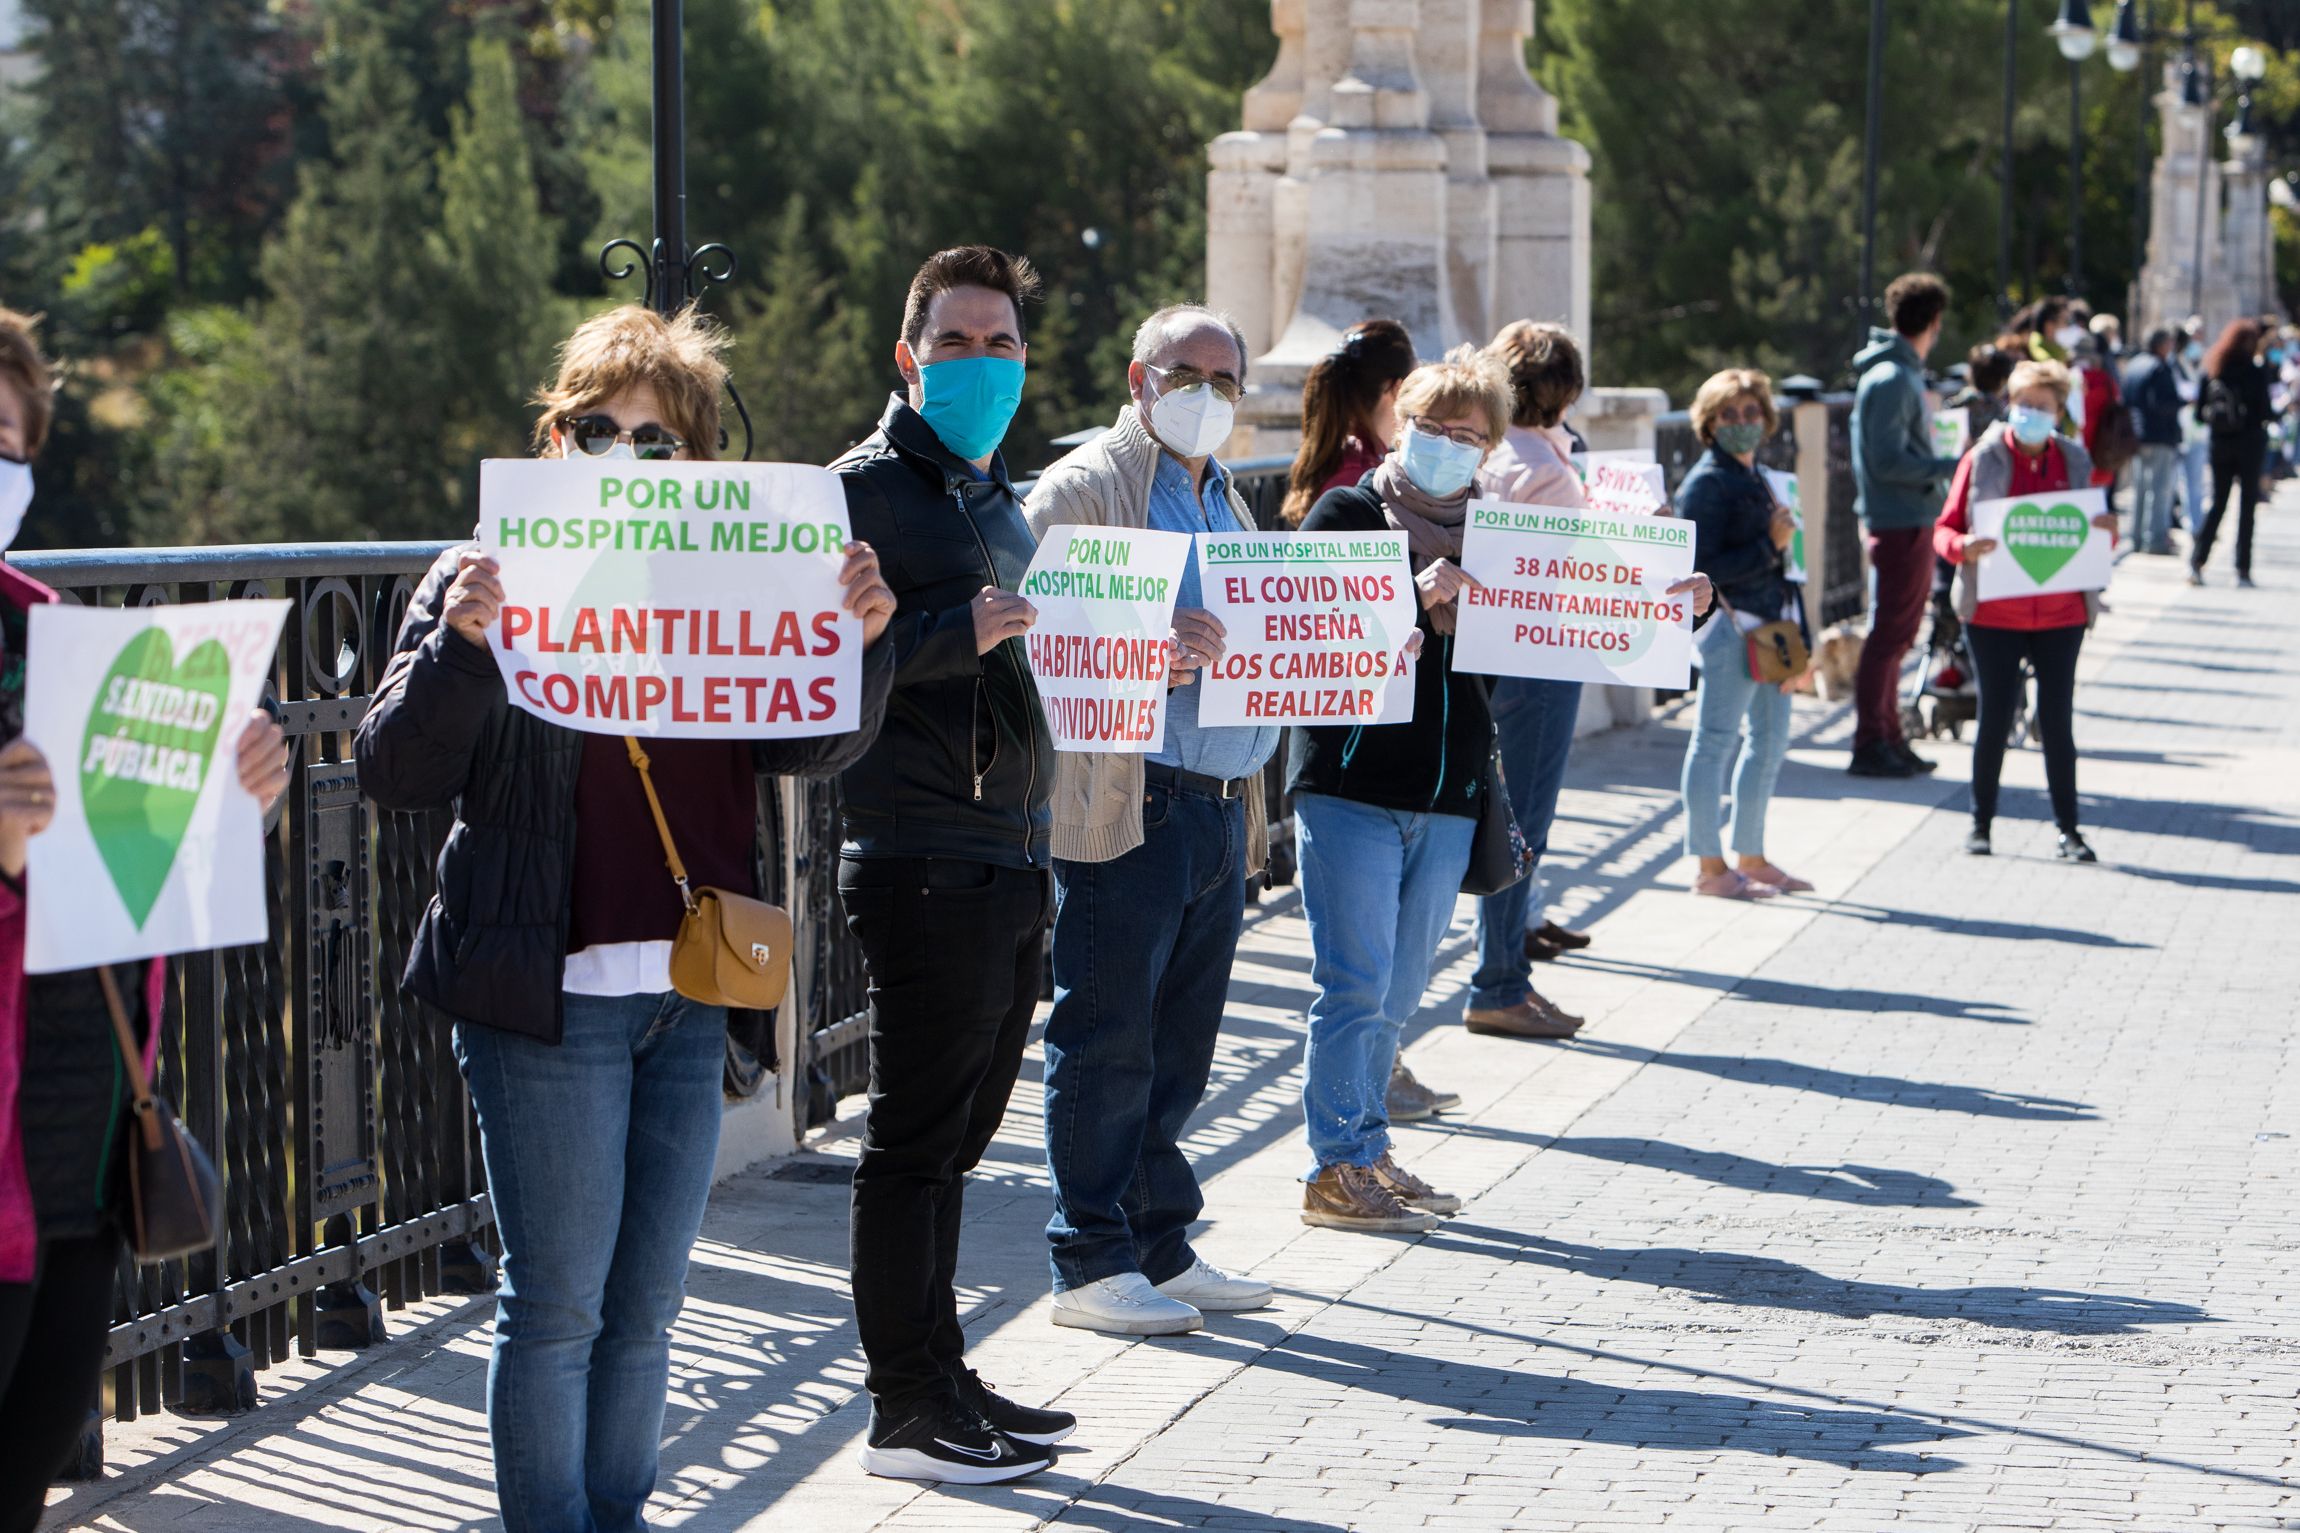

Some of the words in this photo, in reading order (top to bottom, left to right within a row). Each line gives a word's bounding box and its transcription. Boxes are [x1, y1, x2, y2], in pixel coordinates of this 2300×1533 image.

[600, 477, 682, 510] POR
[694, 480, 750, 511] UN
[500, 517, 699, 552] HOSPITAL
[710, 522, 844, 554] MEJOR
[1474, 509, 1509, 527] POR
[1514, 513, 1539, 529] UN
[1543, 516, 1629, 538] HOSPITAL
[1632, 521, 1688, 544] MEJOR
[1066, 538, 1102, 565] POR
[1104, 540, 1131, 567] UN
[1206, 543, 1242, 559] POR
[1246, 543, 1269, 558] UN
[1272, 542, 1346, 558] HOSPITAL
[1349, 541, 1401, 557] MEJOR
[1025, 570, 1104, 600] HOSPITAL
[1108, 574, 1169, 603] MEJOR
[1514, 557, 1540, 577] 38
[1545, 556, 1607, 583] AÑOS
[1613, 565, 1643, 586] DE
[1225, 577, 1255, 604] EL
[1260, 575, 1338, 603] COVID
[1343, 575, 1395, 602] NOS
[1468, 586, 1683, 623] ENFRENTAMIENTOS
[501, 601, 841, 657] PLANTILLAS
[1265, 607, 1364, 641] ENSEÑA
[1514, 623, 1630, 652] POLÍTICOS
[1030, 633, 1169, 682] HABITACIONES
[1211, 653, 1263, 680] LOS
[1269, 651, 1388, 680] CAMBIOS
[1394, 650, 1407, 677] A
[102, 674, 219, 732] SANIDAD
[515, 670, 837, 724] COMPLETAS
[1246, 689, 1374, 718] REALIZAR
[83, 725, 202, 793] PÚBLICA
